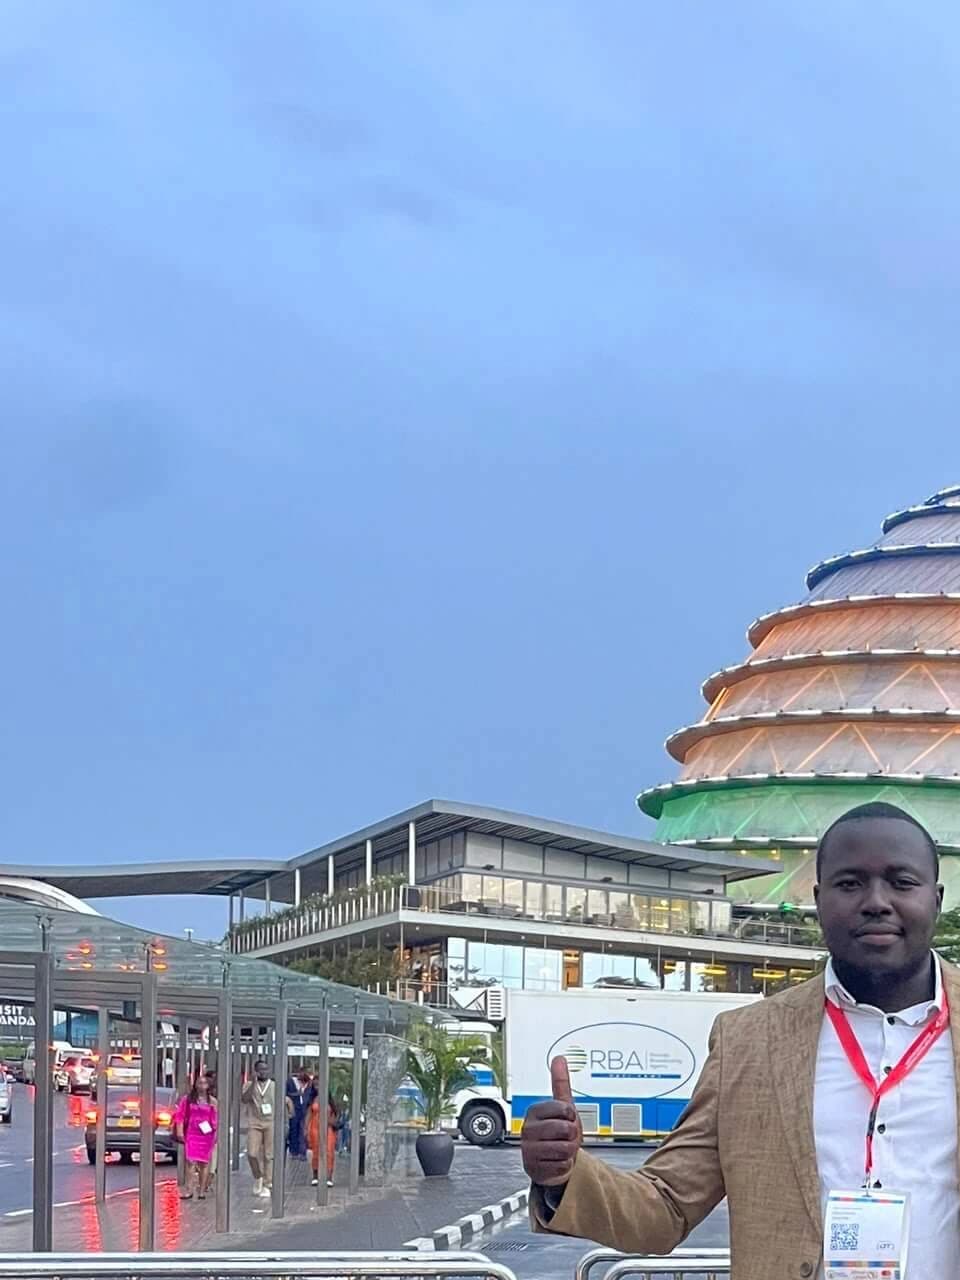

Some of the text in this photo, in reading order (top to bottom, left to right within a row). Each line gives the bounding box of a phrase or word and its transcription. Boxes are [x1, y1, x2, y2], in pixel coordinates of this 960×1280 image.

[0, 1005, 24, 1015] ISIT
[0, 1015, 36, 1026] ANDA
[590, 1050, 644, 1070] RBA
